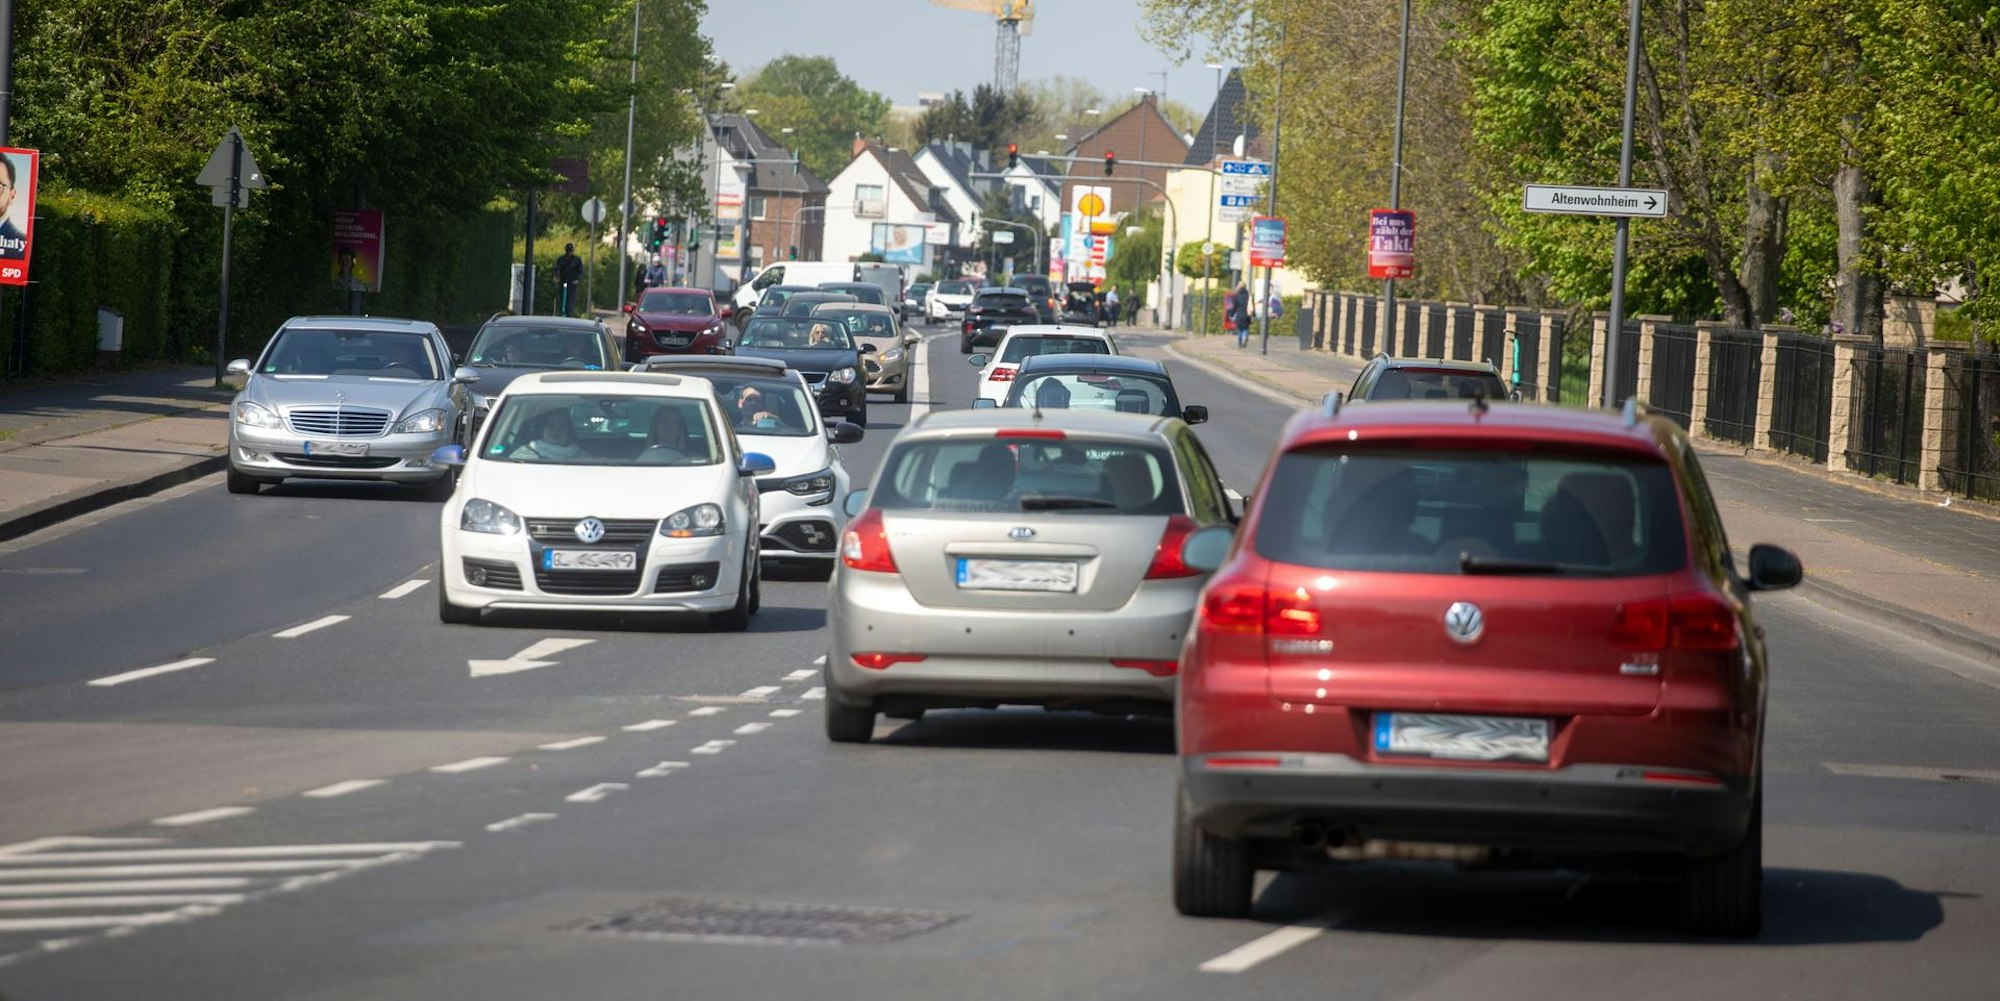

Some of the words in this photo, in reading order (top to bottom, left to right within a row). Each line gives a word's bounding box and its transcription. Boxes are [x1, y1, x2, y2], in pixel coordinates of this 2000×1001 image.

[1551, 192, 1638, 208] Altenwohnheim
[1372, 216, 1388, 226] Bei
[1375, 225, 1399, 235] zählt
[1371, 234, 1413, 251] Takt.
[2, 267, 22, 278] SPD
